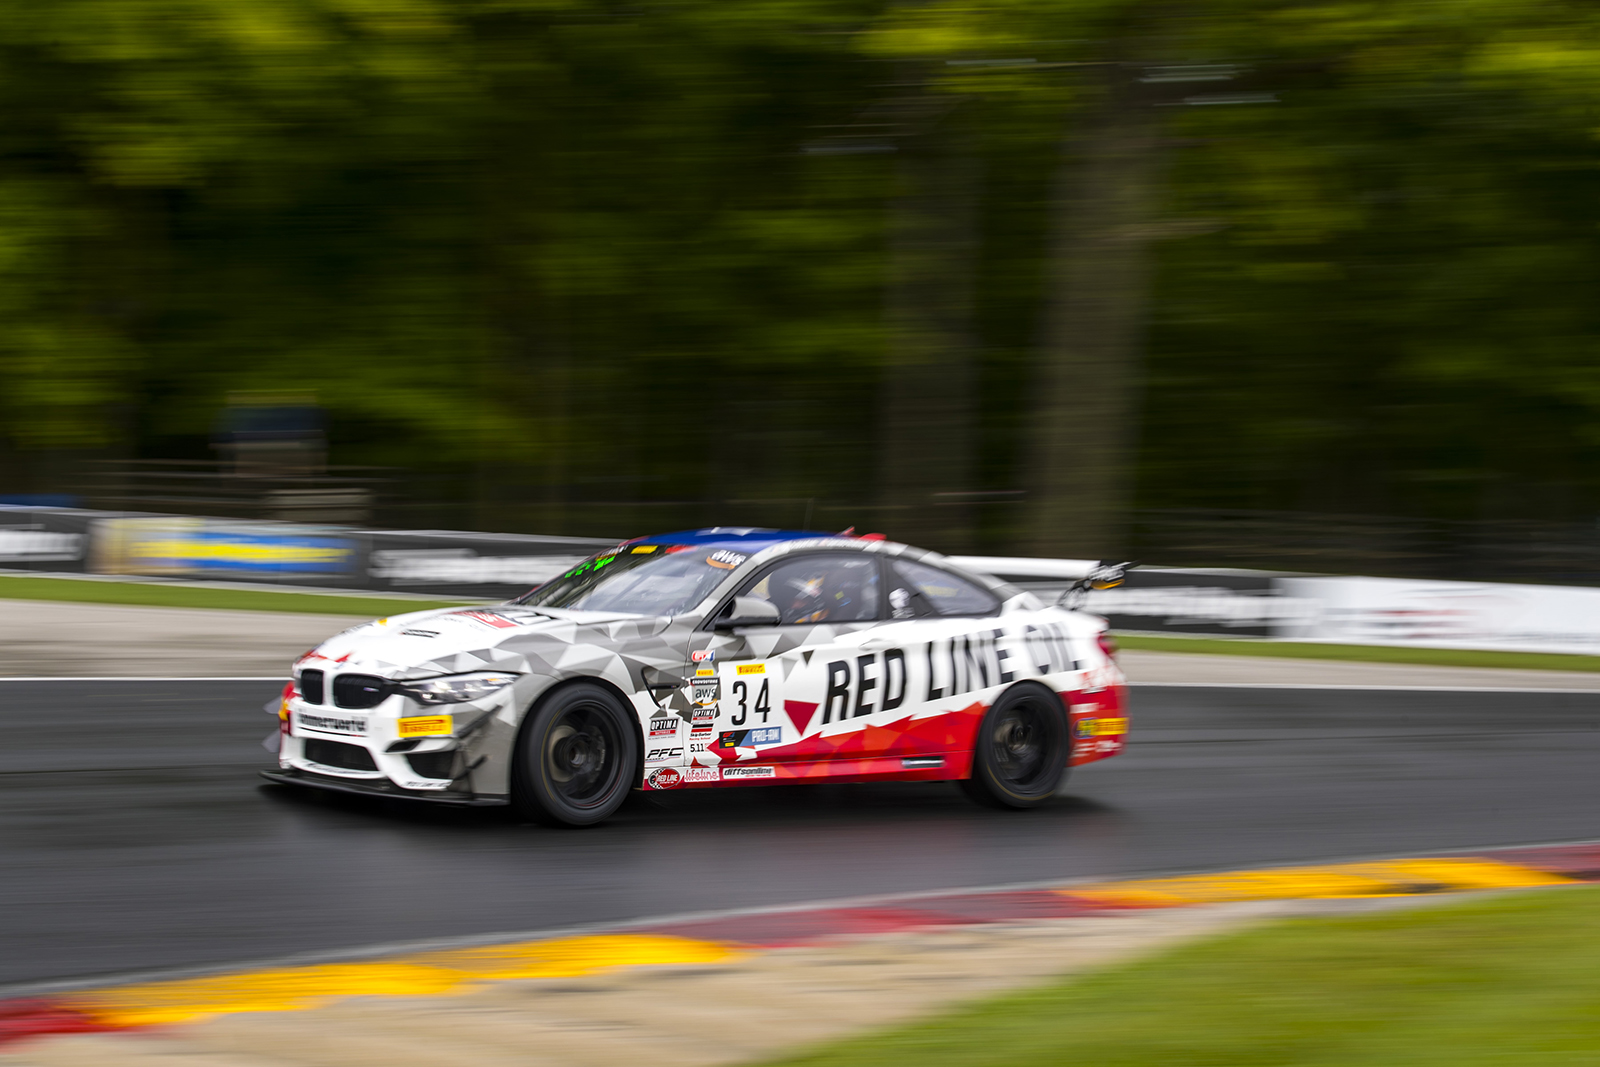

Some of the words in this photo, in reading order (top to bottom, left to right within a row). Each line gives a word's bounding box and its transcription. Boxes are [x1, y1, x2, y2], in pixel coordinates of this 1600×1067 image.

[821, 647, 907, 726] RED
[926, 628, 1016, 702] LINE
[1023, 621, 1082, 674] OIL
[695, 687, 717, 699] aws
[731, 678, 771, 726] 34
[694, 709, 714, 717] OPTIMA
[651, 720, 676, 730] OPTIMA
[751, 728, 780, 742] PRO-AM
[647, 747, 683, 758] PFC
[690, 743, 705, 752] 5.11
[685, 769, 719, 781] lifeline
[724, 767, 772, 776] diffsonline
[657, 774, 667, 782] RED
[667, 773, 678, 781] LINE
